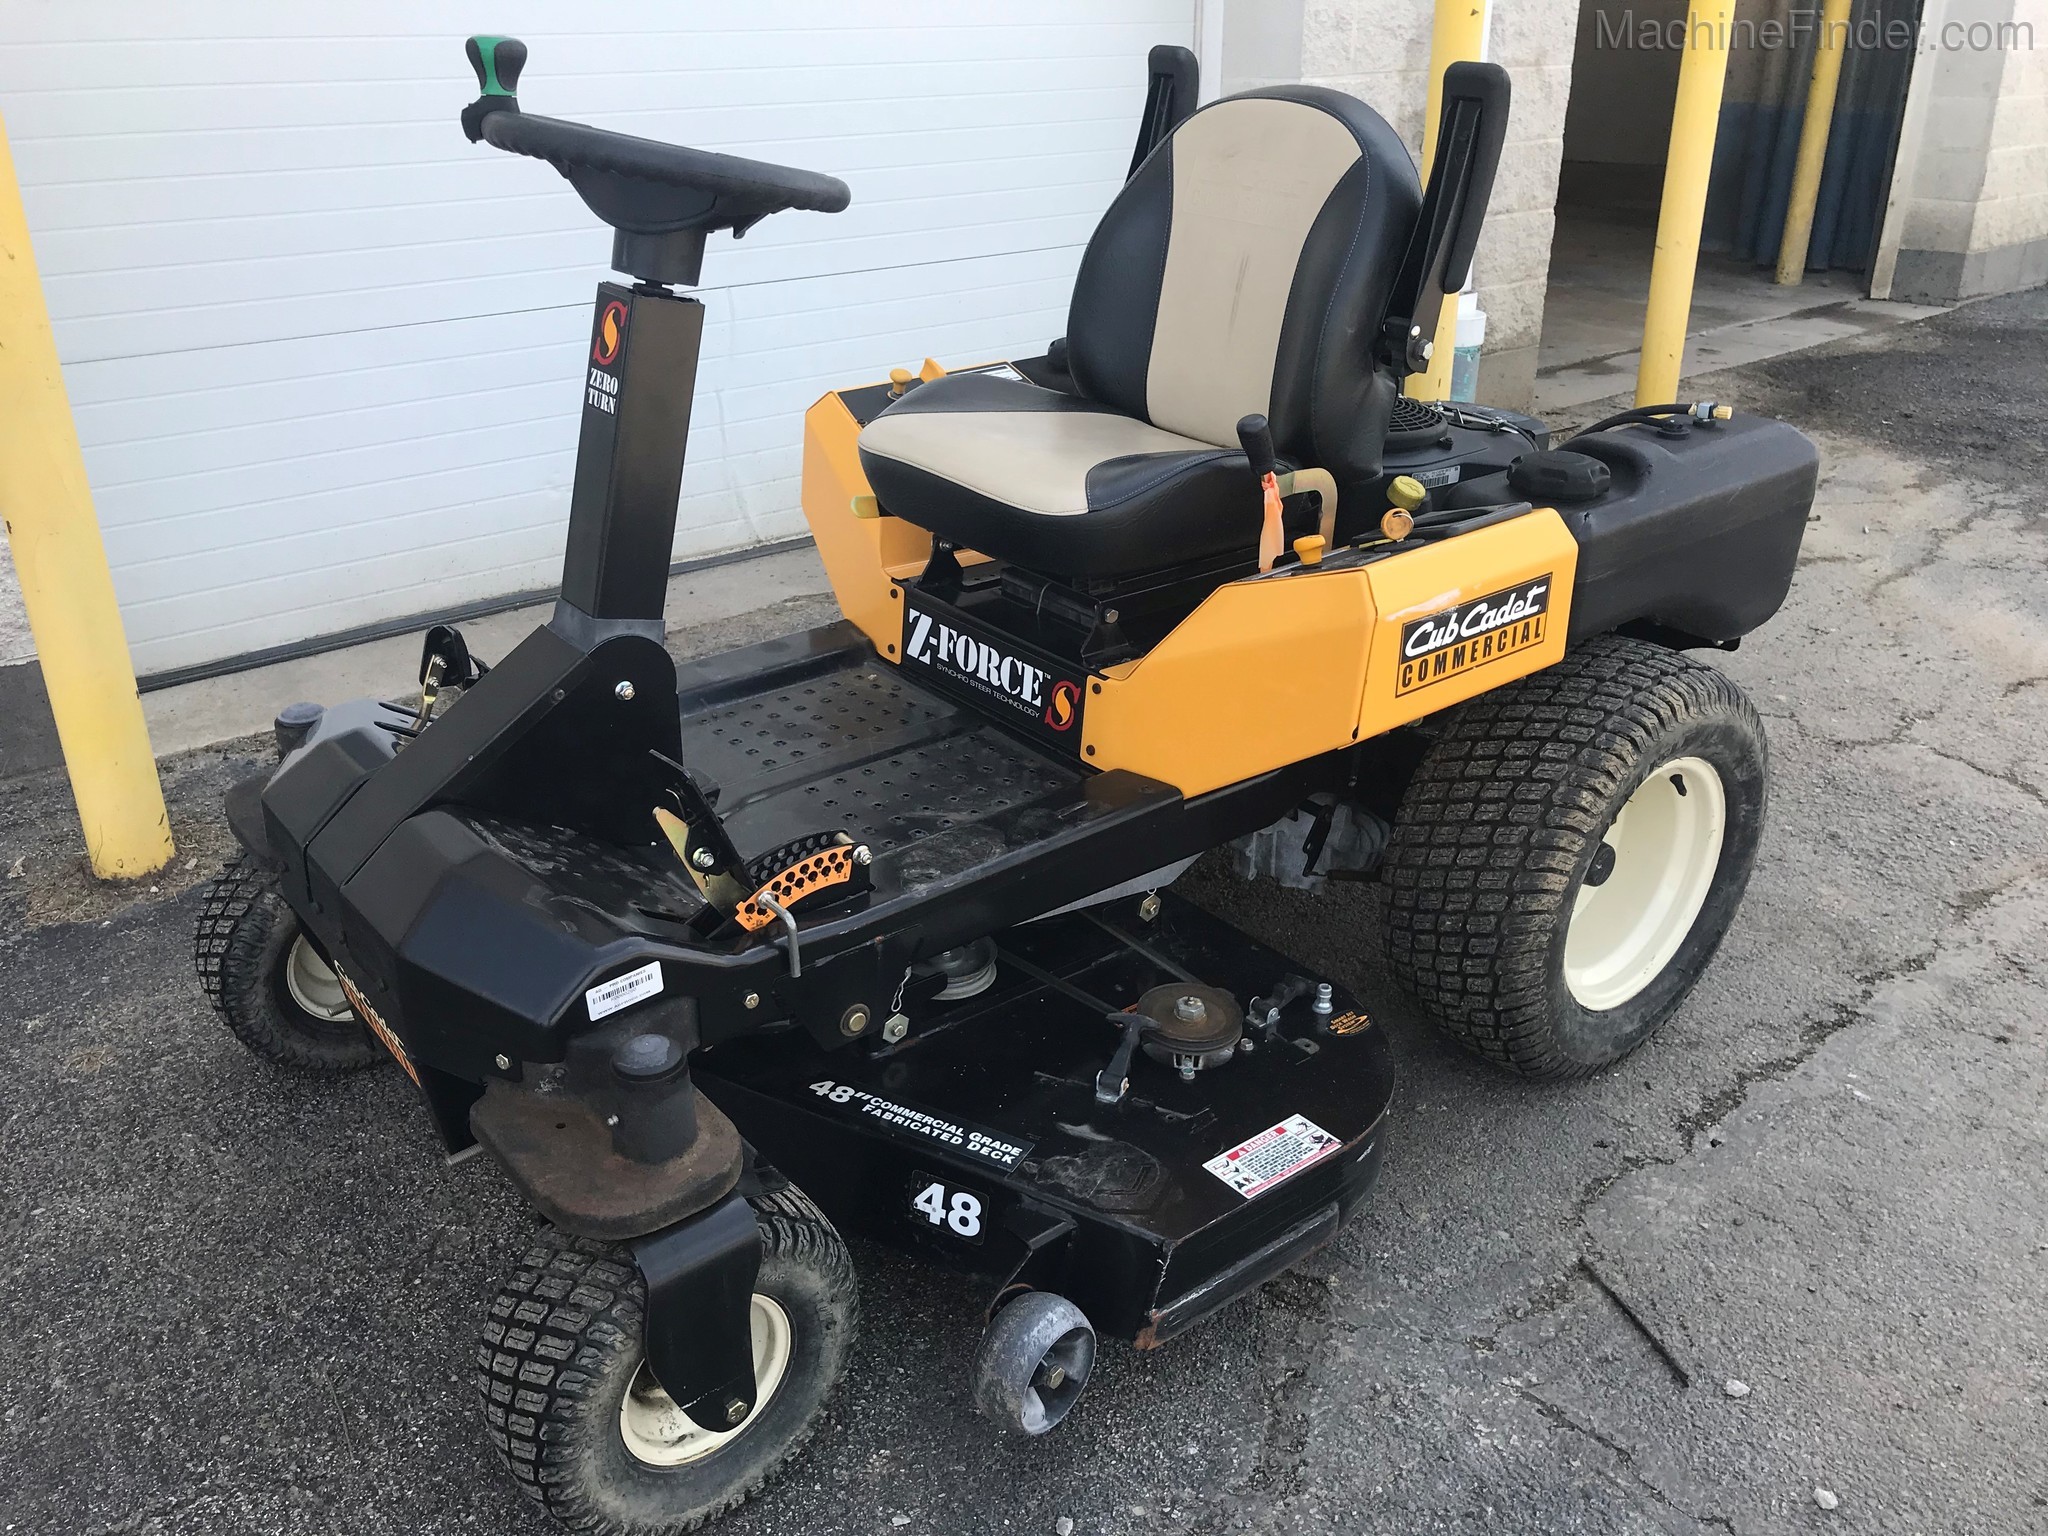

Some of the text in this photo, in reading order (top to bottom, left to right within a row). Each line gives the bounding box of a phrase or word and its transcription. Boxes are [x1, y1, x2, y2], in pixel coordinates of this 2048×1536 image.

[588, 387, 617, 415] TURN
[590, 367, 619, 395] ZERO
[1405, 585, 1547, 657] Cub Cadet
[1402, 617, 1541, 688] COMMERCIAL
[936, 663, 1040, 719] SYNCHRO STEER TECHNOLOGY
[862, 1103, 1016, 1164] FABRICATED DECK
[870, 1097, 965, 1137] COMMERCIAL
[968, 1131, 1023, 1157] GRADE
[1245, 1130, 1280, 1151] DANGER
[913, 1182, 982, 1237] 48
